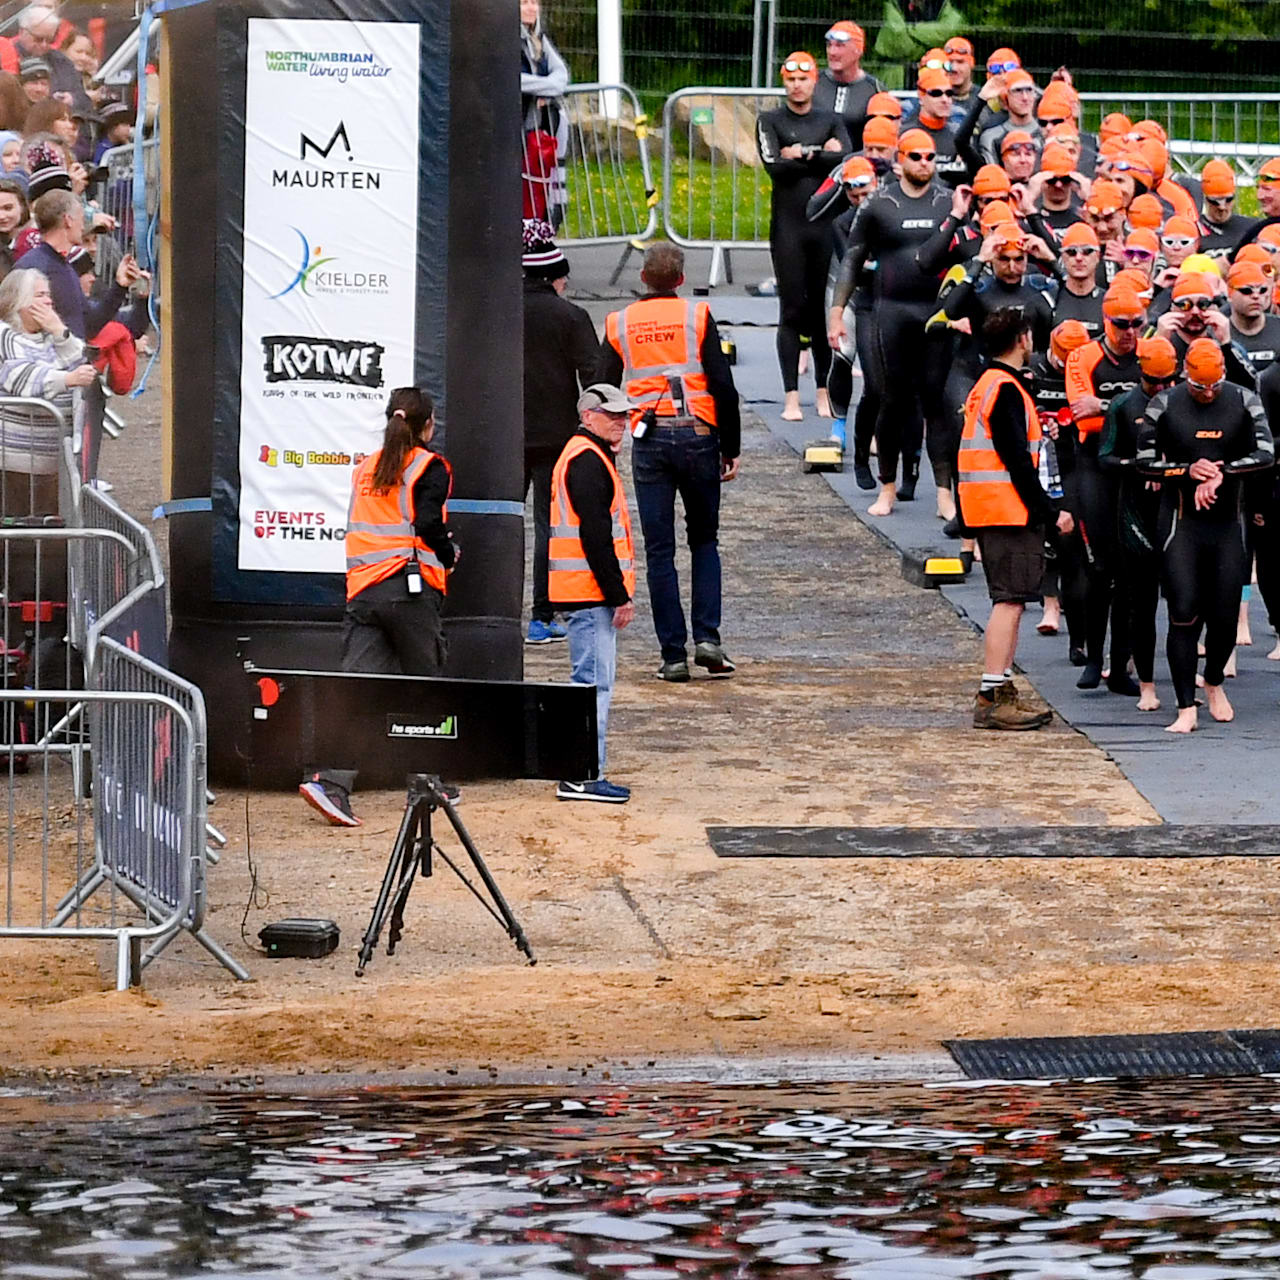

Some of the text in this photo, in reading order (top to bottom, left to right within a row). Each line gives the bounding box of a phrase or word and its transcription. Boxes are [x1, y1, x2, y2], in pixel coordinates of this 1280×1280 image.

[265, 51, 373, 63] NORTHUMBRIAN
[267, 62, 392, 83] WATER living water
[272, 170, 380, 190] MAURTEN
[315, 272, 389, 287] KIELDER
[635, 332, 676, 344] CREW
[273, 343, 375, 378] KOTWF
[284, 450, 303, 467] Big
[307, 450, 351, 465] Bobble
[254, 510, 326, 525] EVENTS
[254, 526, 347, 541] OF THE NO
[404, 726, 434, 735] sports
